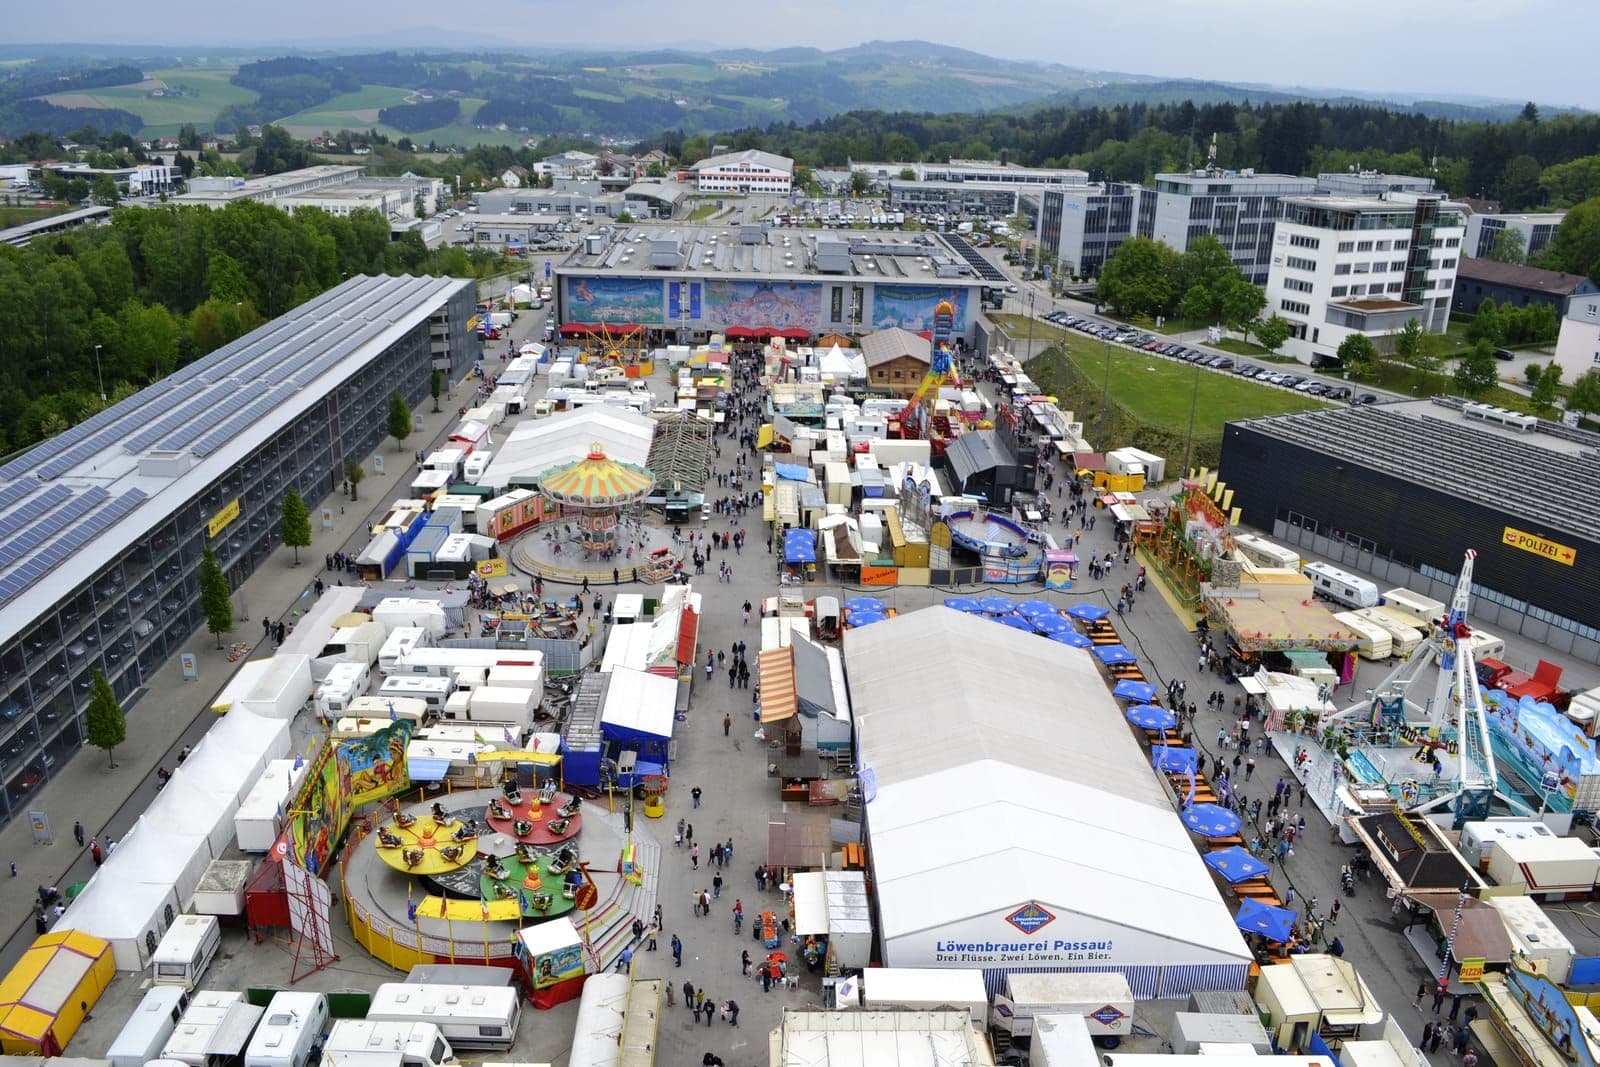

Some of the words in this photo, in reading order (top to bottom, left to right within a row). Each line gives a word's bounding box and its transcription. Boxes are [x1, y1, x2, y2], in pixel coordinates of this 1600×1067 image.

[1519, 535, 1558, 557] POLIZEI
[936, 940, 1048, 953] Löwenbrauerei
[1053, 940, 1106, 951] Passau
[937, 953, 958, 962] Drei
[961, 953, 997, 962] Flüsse.
[1000, 953, 1024, 962] Zwei
[1028, 952, 1064, 961] Löwen.
[1068, 952, 1084, 961] Ein
[1088, 951, 1111, 961] Bier.
[1461, 968, 1482, 976] PIZZA
